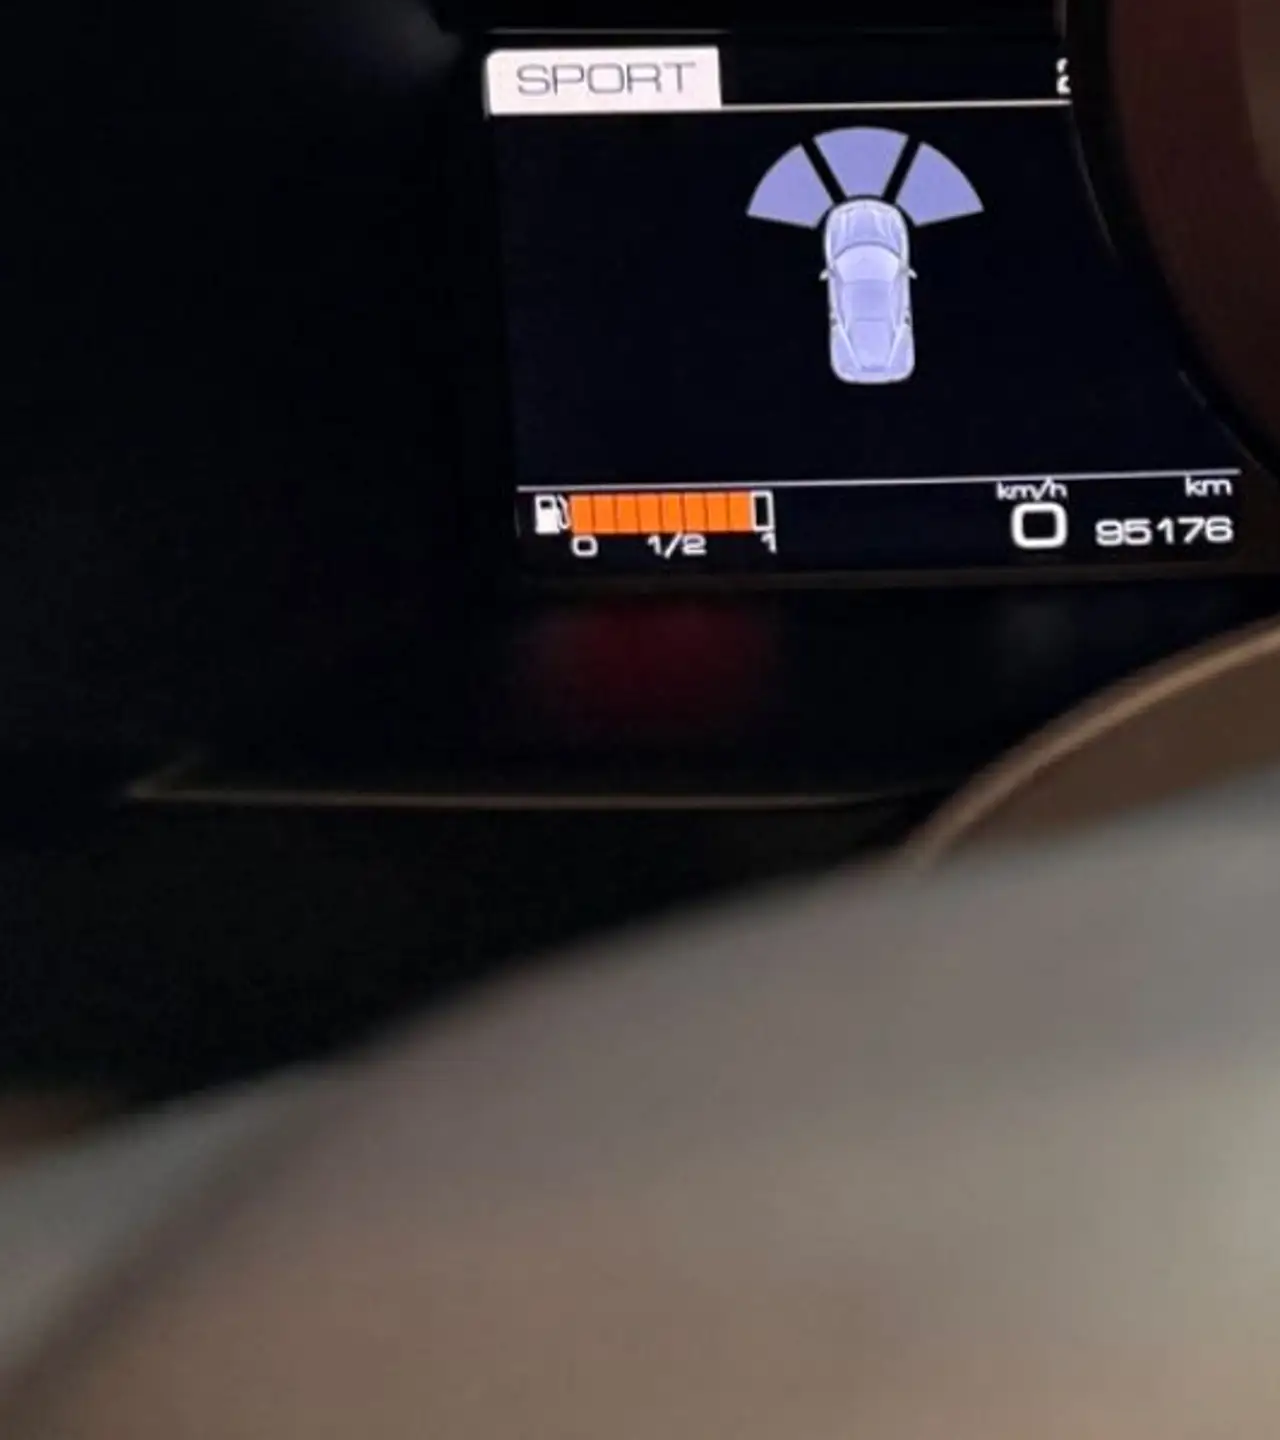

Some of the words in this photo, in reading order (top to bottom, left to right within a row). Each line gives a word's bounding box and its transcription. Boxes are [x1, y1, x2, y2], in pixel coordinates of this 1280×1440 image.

[516, 62, 695, 94] SPORT
[997, 478, 1066, 500] km/h
[1186, 477, 1231, 495] km
[1012, 502, 1066, 548] 0
[1096, 517, 1232, 545] 95176
[572, 537, 599, 557] 0
[648, 534, 706, 558] 1/2
[762, 531, 777, 553] 1
